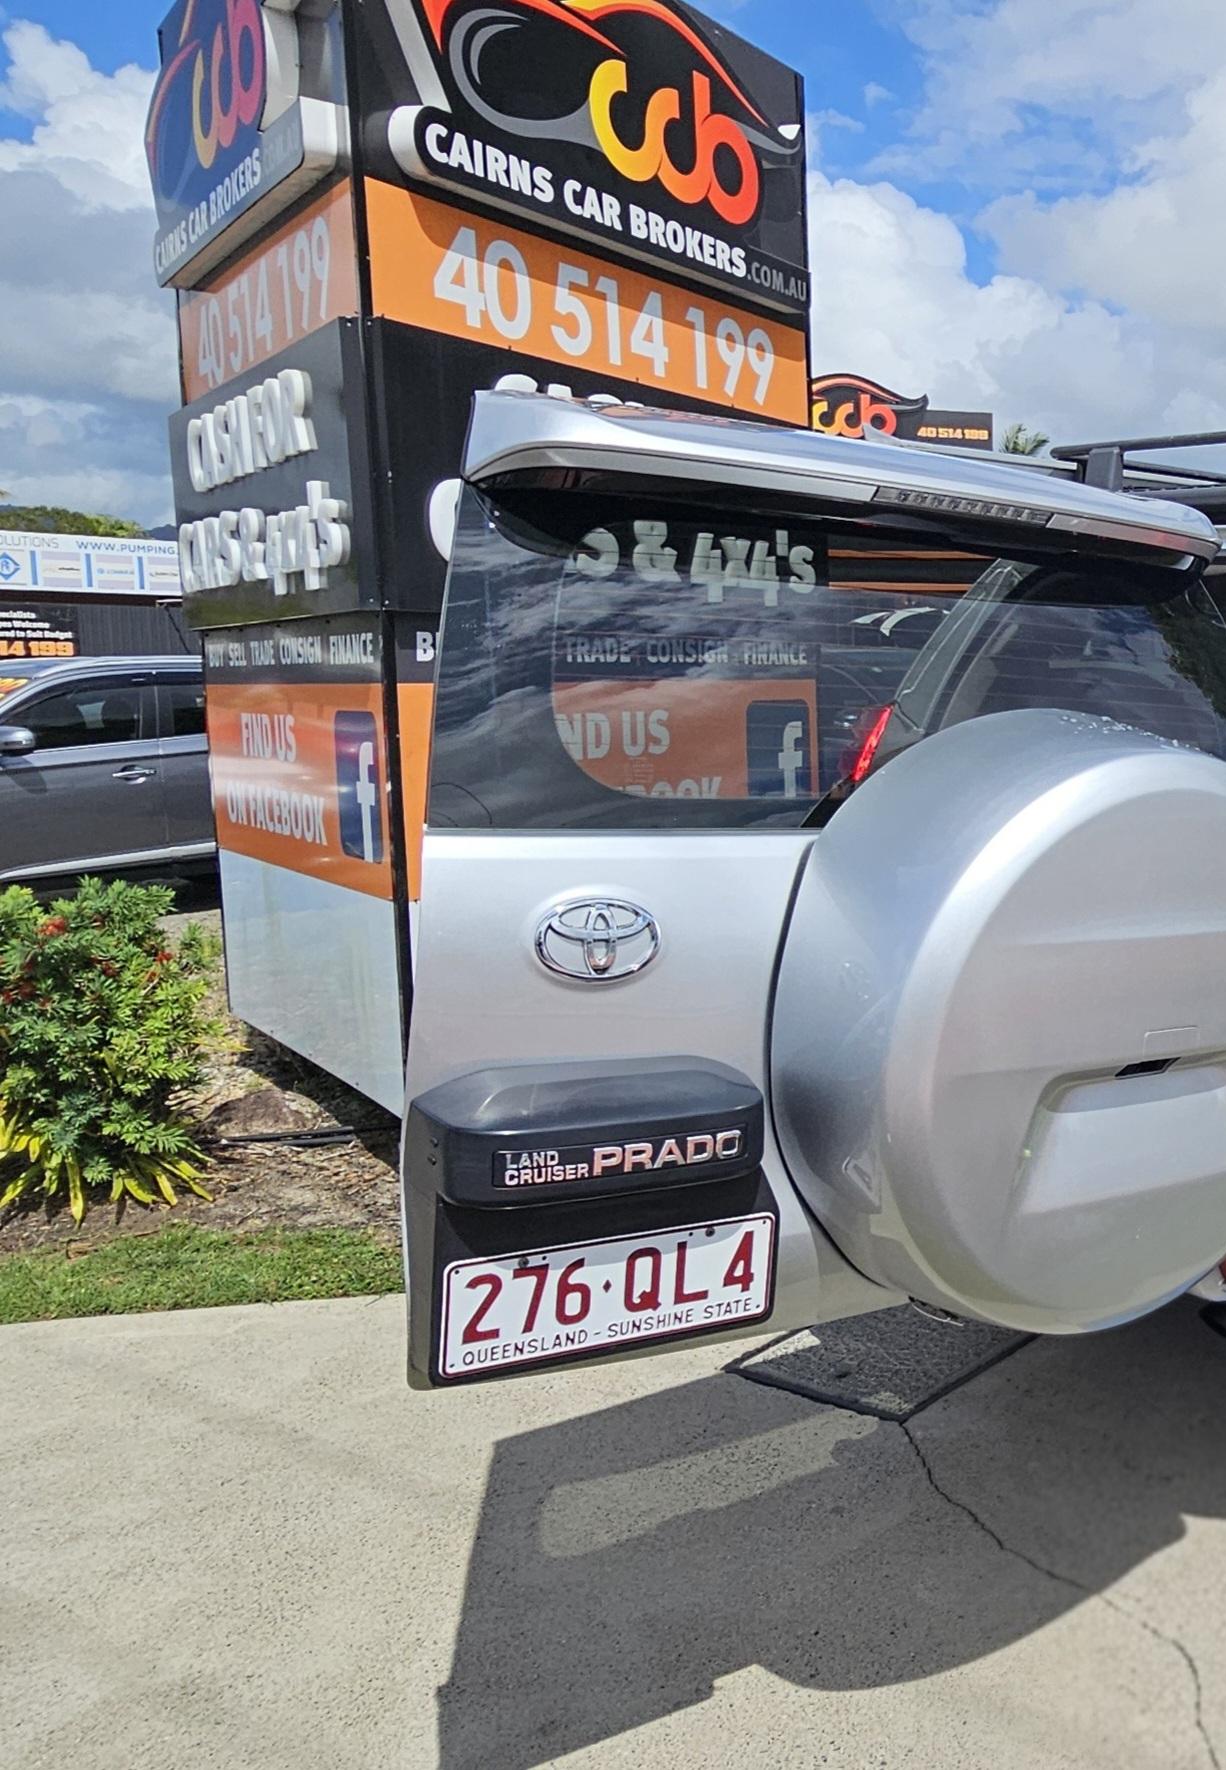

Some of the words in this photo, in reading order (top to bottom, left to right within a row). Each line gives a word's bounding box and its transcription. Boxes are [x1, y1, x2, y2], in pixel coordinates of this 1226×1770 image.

[425, 122, 555, 203] CAIRNS
[563, 178, 623, 231] CAR
[155, 219, 188, 274] CAIRNS
[188, 200, 209, 244] CAR
[198, 298, 225, 390] 40
[226, 256, 273, 373] 514
[277, 215, 330, 339] 199
[433, 225, 532, 340] 40
[551, 262, 669, 378] 514
[685, 306, 774, 406] 199
[187, 394, 255, 492] CASH
[245, 369, 319, 468] FOR
[178, 510, 242, 594] CARS
[207, 643, 226, 668] BUY
[228, 641, 248, 666] SELL
[249, 639, 276, 667] TRADE
[279, 635, 322, 667] CONSIGN
[328, 632, 374, 666] FINANCE
[566, 636, 632, 664] TRADE
[646, 637, 729, 665] CONSIGN
[743, 639, 809, 666] FINANCE
[240, 712, 273, 758] FIND
[273, 713, 298, 763] US
[555, 712, 611, 760] ND
[621, 709, 671, 757] US
[226, 779, 249, 824] ON
[247, 785, 328, 846] FACEBOOK
[504, 1162, 590, 1186] CRUISER
[505, 1150, 559, 1170] LAND
[592, 1128, 742, 1176] PRADO
[462, 1330, 588, 1367] QUEENSLAND
[607, 1307, 694, 1338] SUNSHINE
[703, 1297, 753, 1319] STATE
